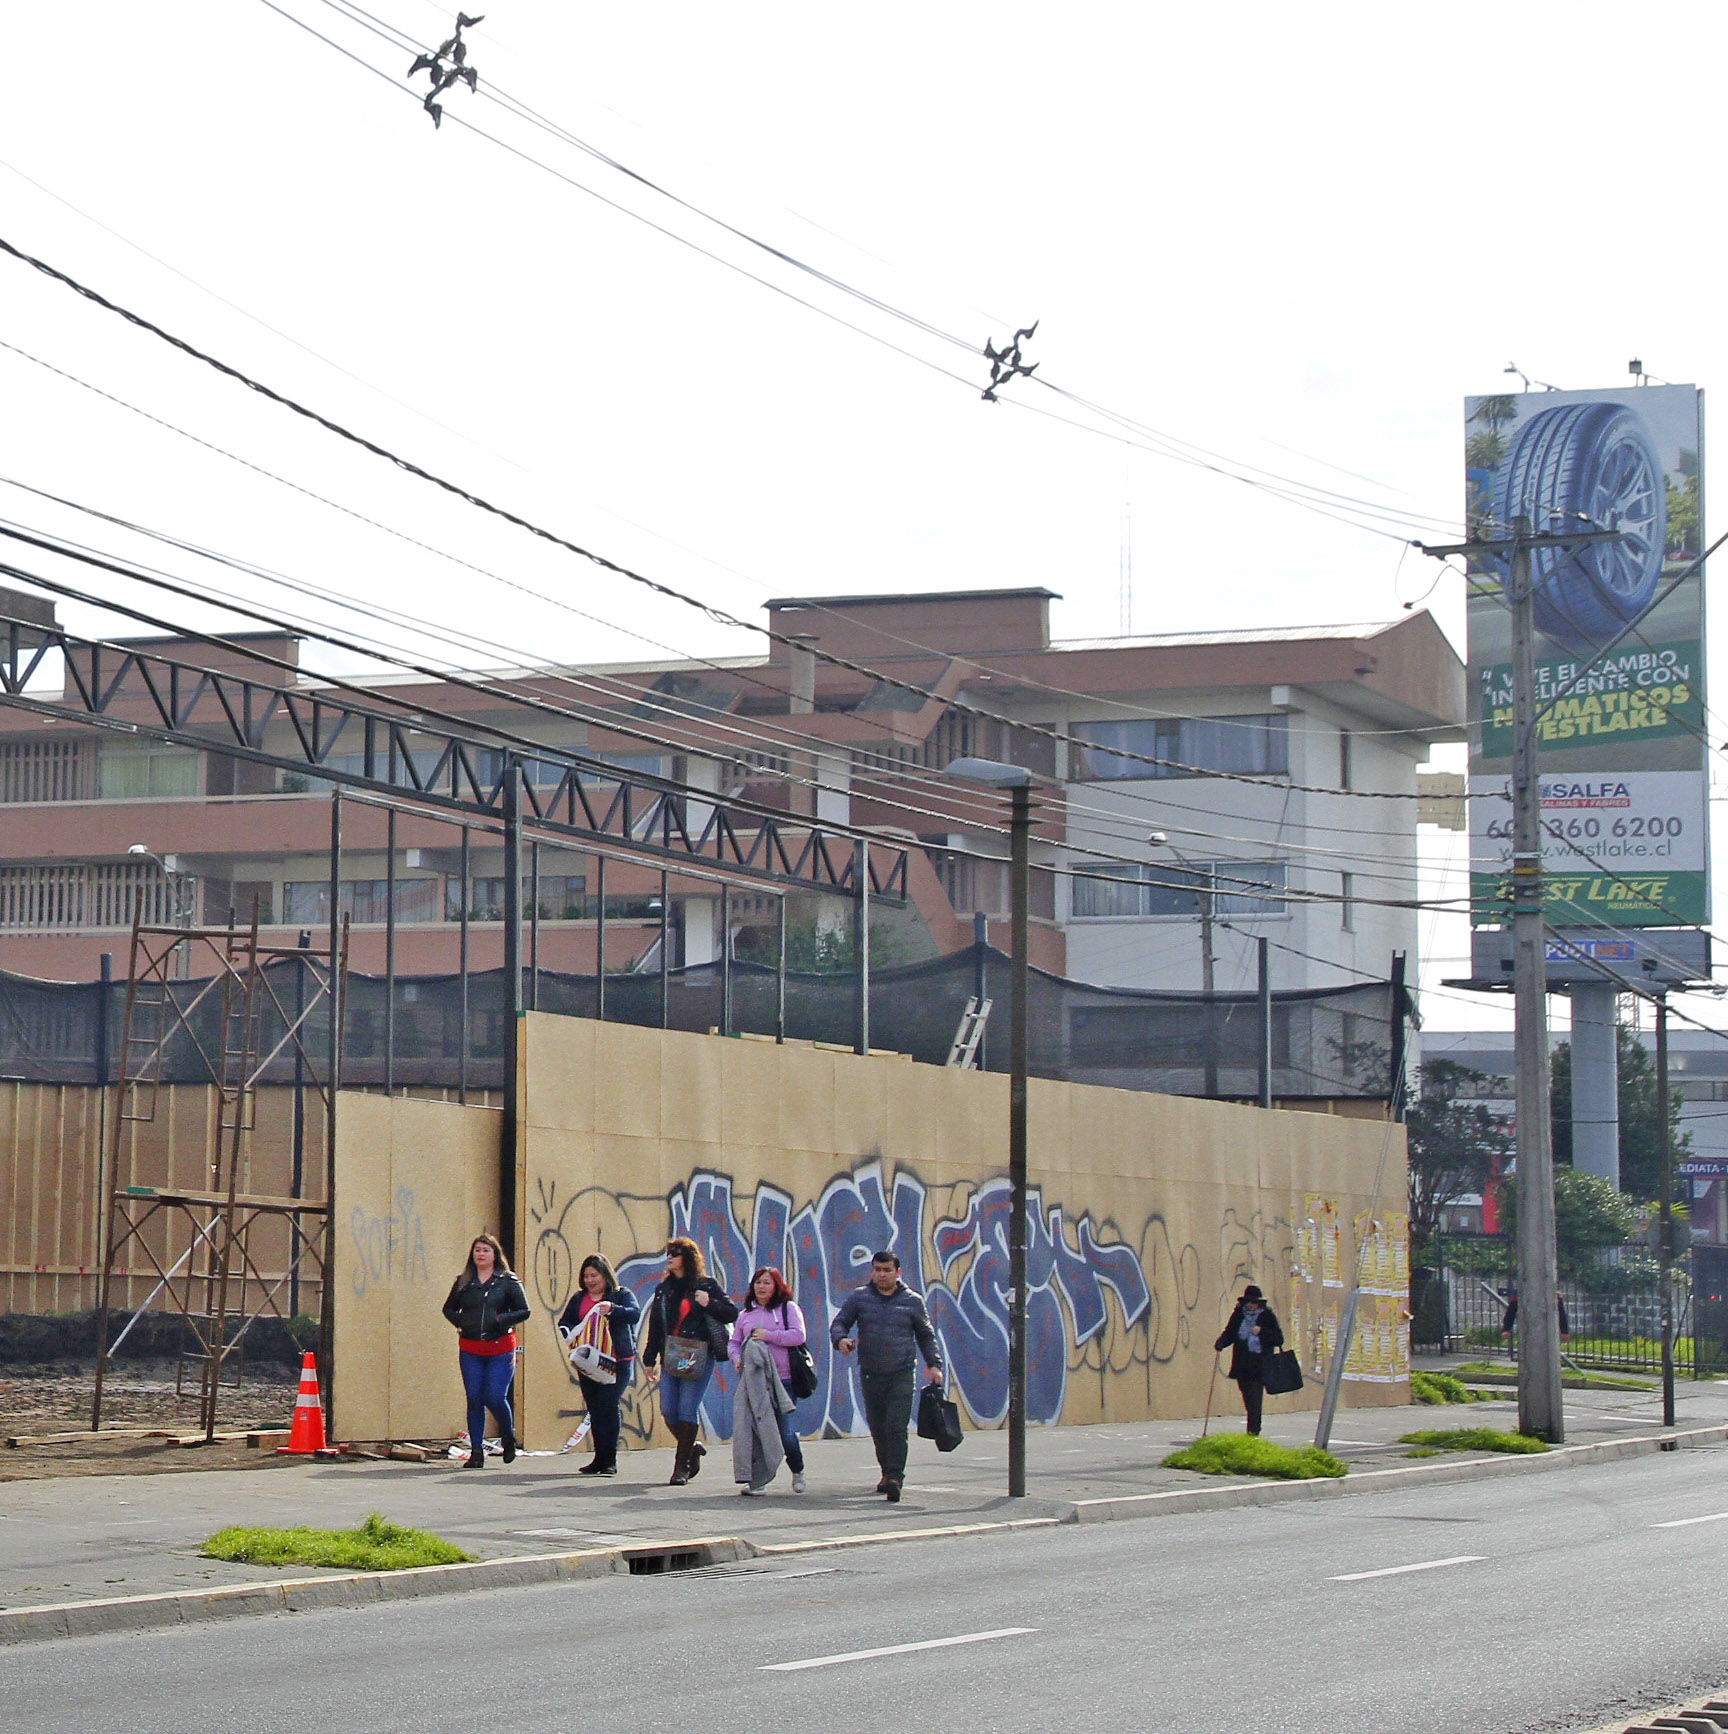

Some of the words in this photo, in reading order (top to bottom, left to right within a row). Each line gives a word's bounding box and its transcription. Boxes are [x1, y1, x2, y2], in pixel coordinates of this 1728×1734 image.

[1637, 664, 1690, 686] CON
[1493, 683, 1691, 728] NUMÁTICOS
[1535, 707, 1668, 741] ESTLAKE
[1552, 783, 1629, 798] SALFA
[1487, 818, 1515, 839] 60
[1548, 817, 1600, 838] 360
[1612, 816, 1682, 838] 6200
[1587, 878, 1668, 901] LAKE
[351, 1188, 429, 1298] SOFIA
